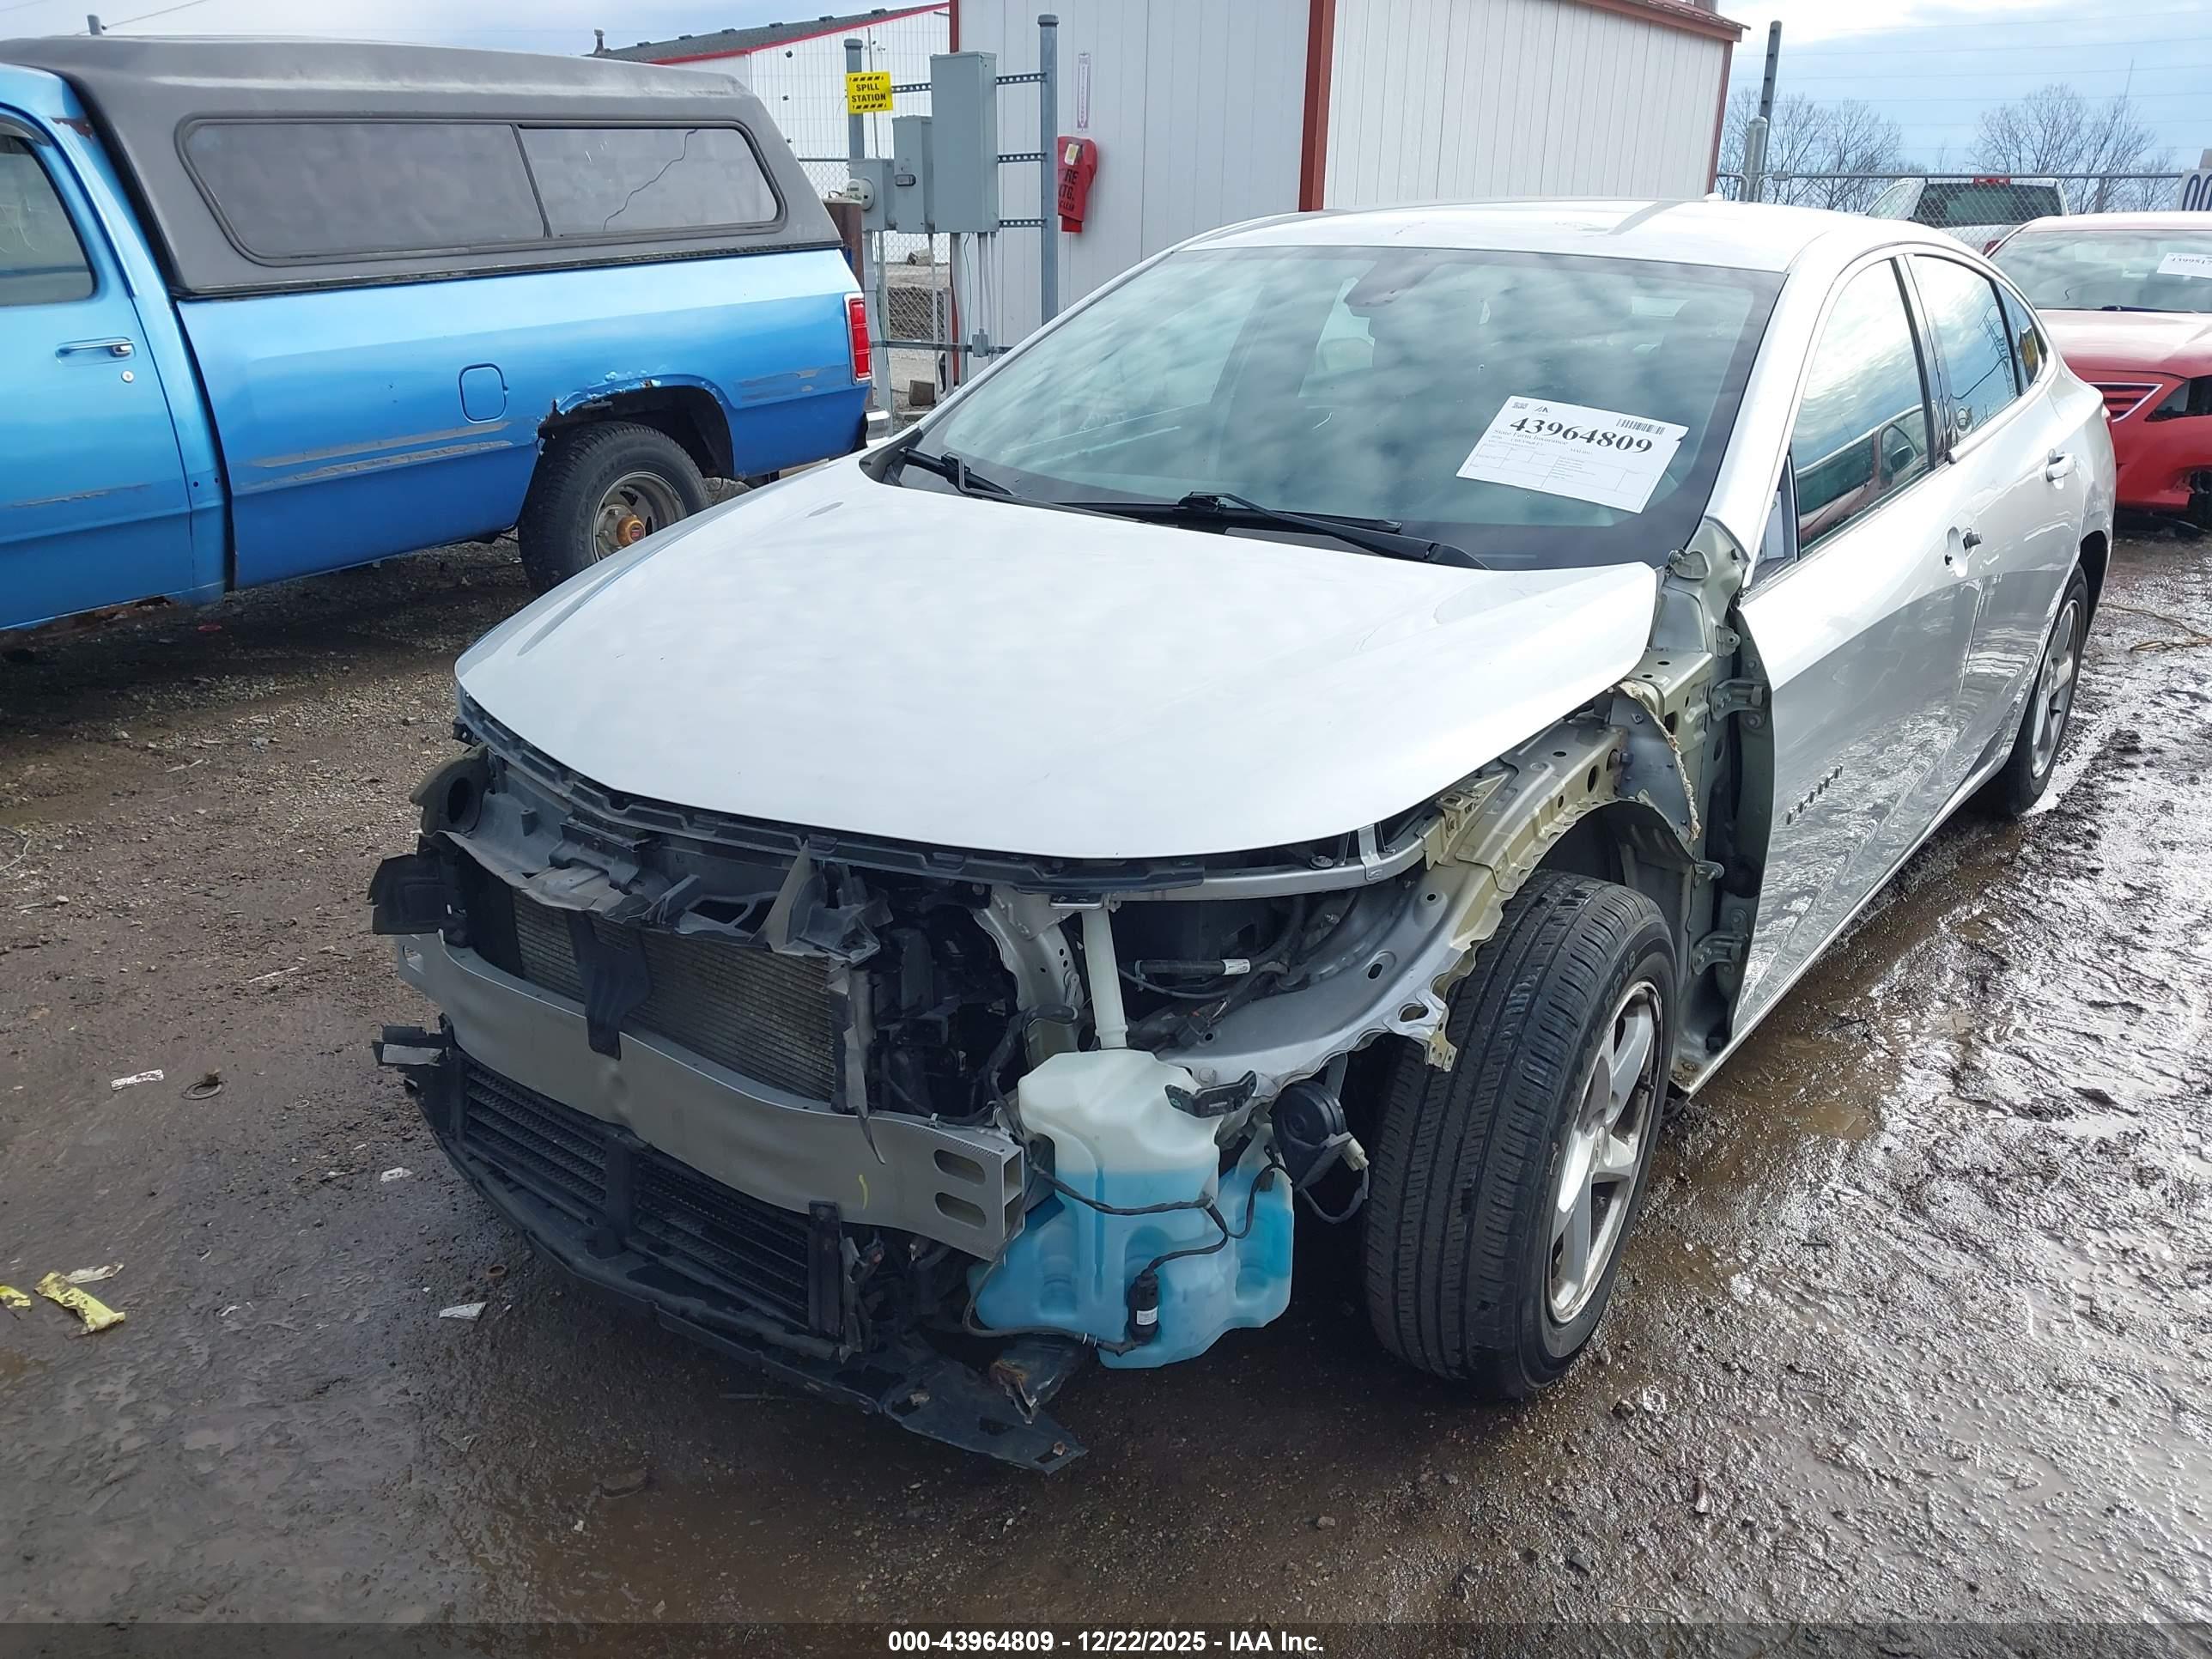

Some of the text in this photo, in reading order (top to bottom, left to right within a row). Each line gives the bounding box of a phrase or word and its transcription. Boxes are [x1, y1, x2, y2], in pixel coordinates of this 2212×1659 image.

[856, 82, 879, 92] SPILL
[851, 93, 886, 103] STATION
[1510, 417, 1653, 453] 43964809
